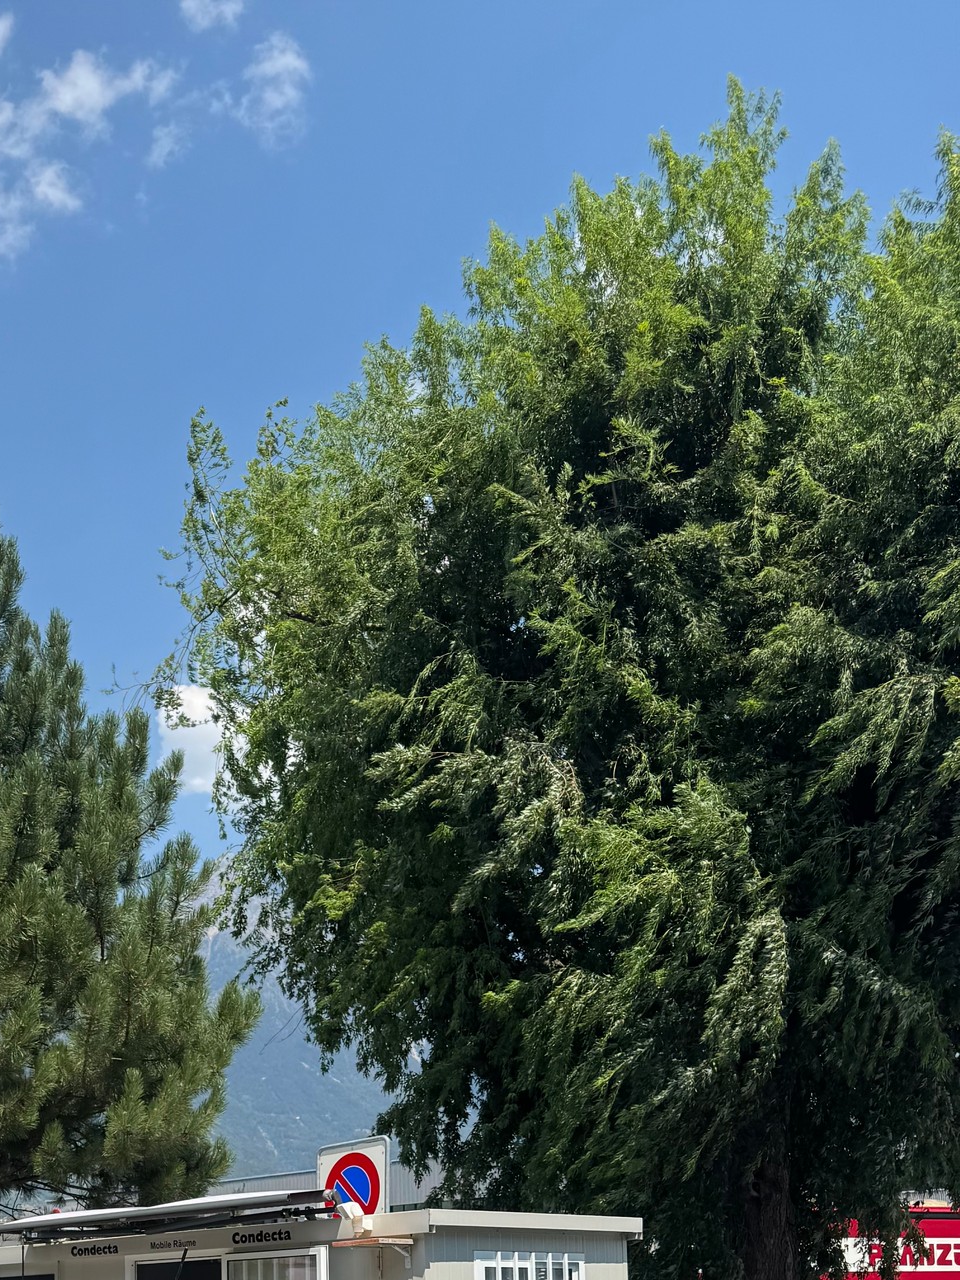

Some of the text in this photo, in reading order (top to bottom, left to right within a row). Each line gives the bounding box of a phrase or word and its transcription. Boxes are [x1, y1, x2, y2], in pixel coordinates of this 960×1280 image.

[231, 1228, 291, 1245] Condecta
[70, 1243, 119, 1257] Condecta
[150, 1239, 197, 1250] Mobile Räume
